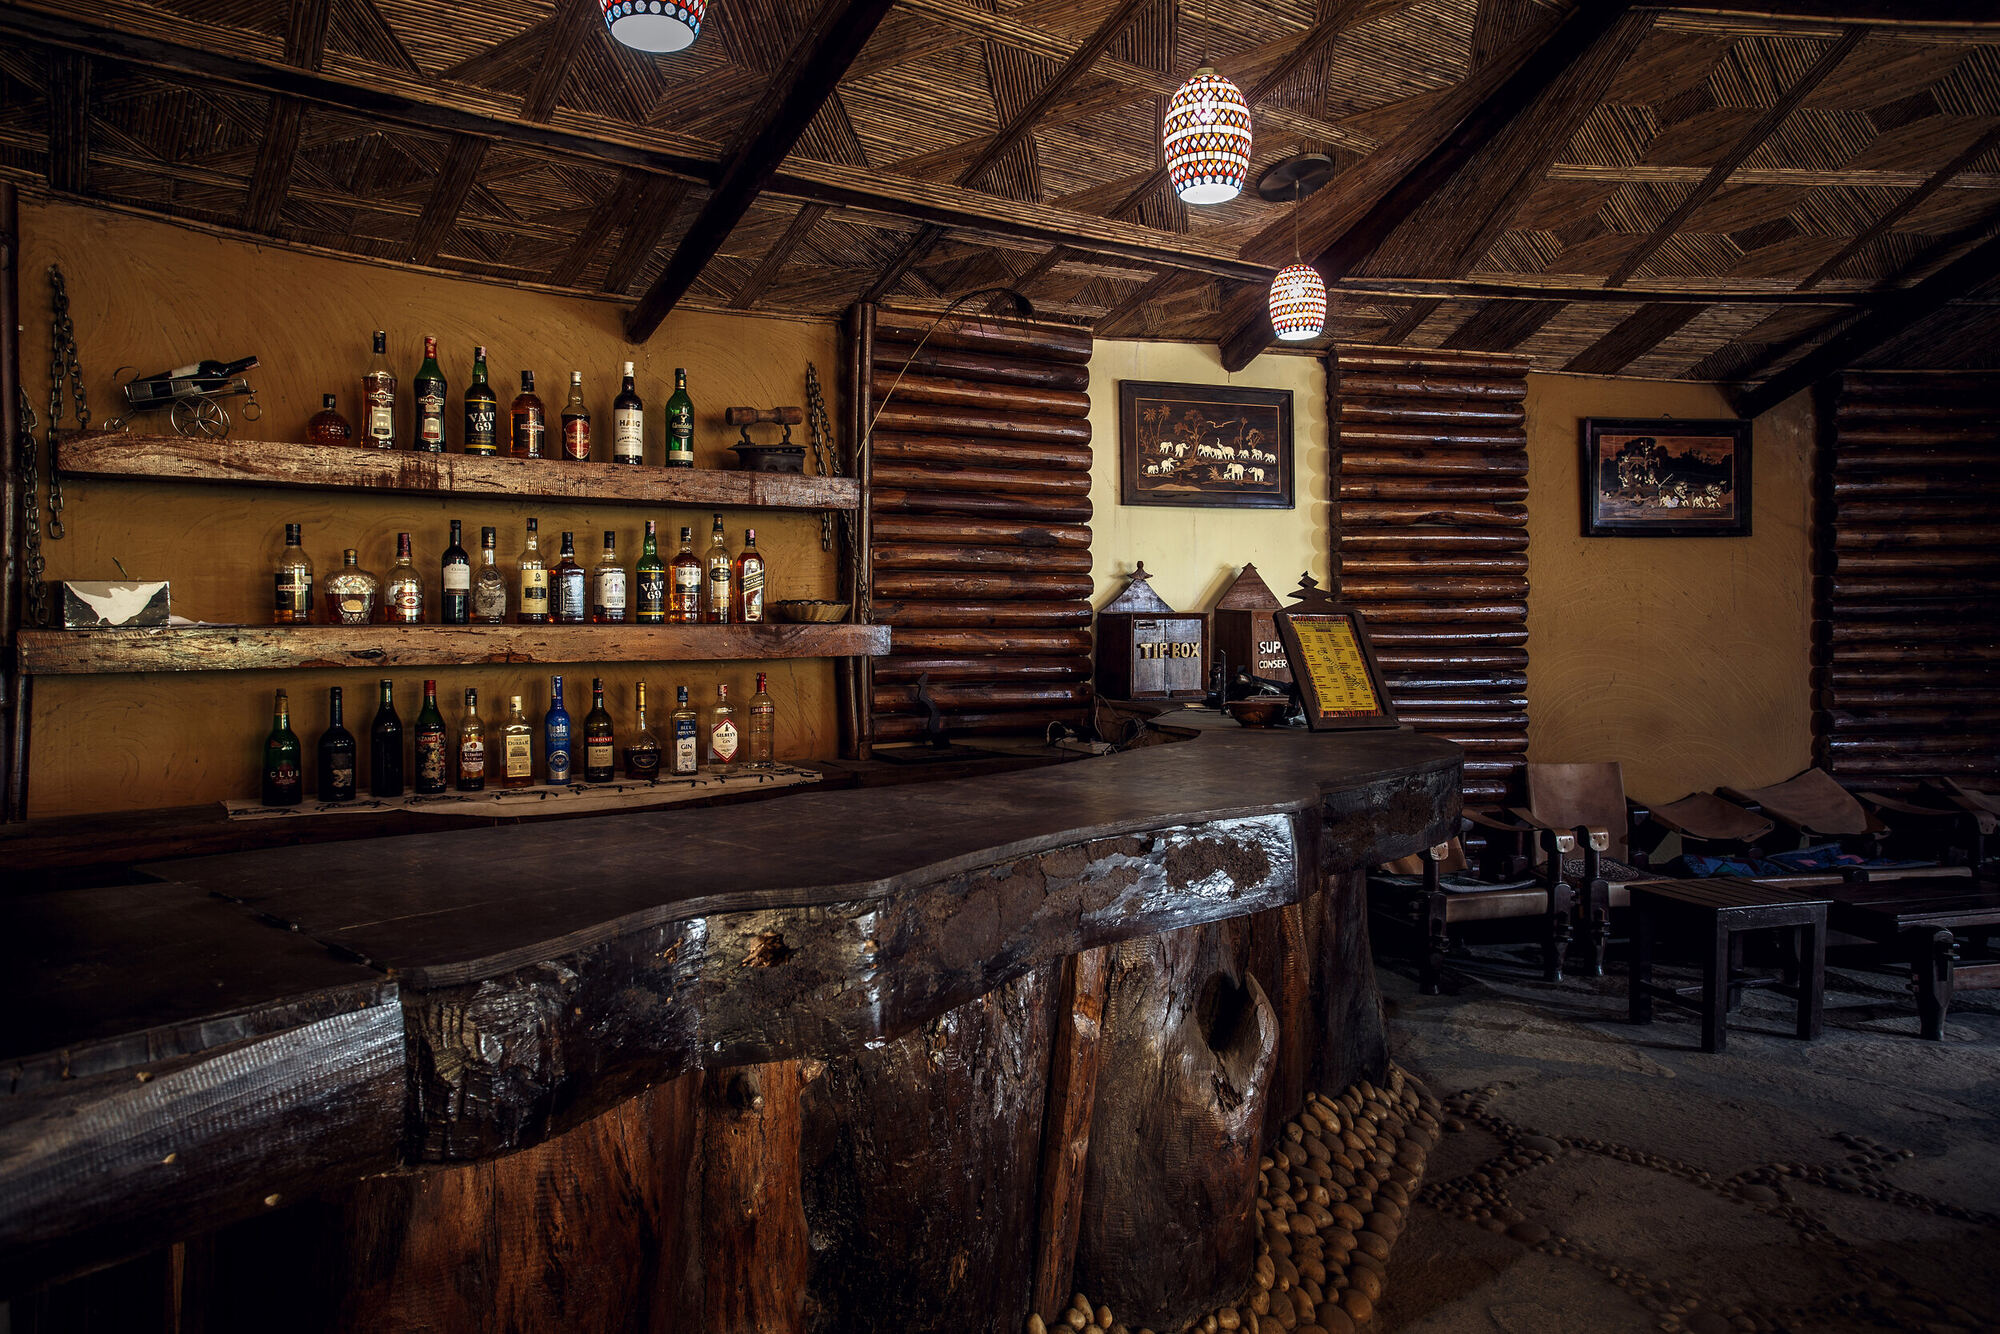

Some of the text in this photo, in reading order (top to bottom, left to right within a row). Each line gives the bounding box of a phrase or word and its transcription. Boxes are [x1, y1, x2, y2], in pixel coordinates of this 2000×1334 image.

[468, 412, 496, 423] VAT
[475, 422, 492, 432] 69
[619, 420, 641, 428] HAIG
[640, 581, 664, 592] VAT
[647, 591, 662, 600] 69
[1140, 642, 1200, 659] TIP BOX
[1258, 659, 1288, 669] CONSER
